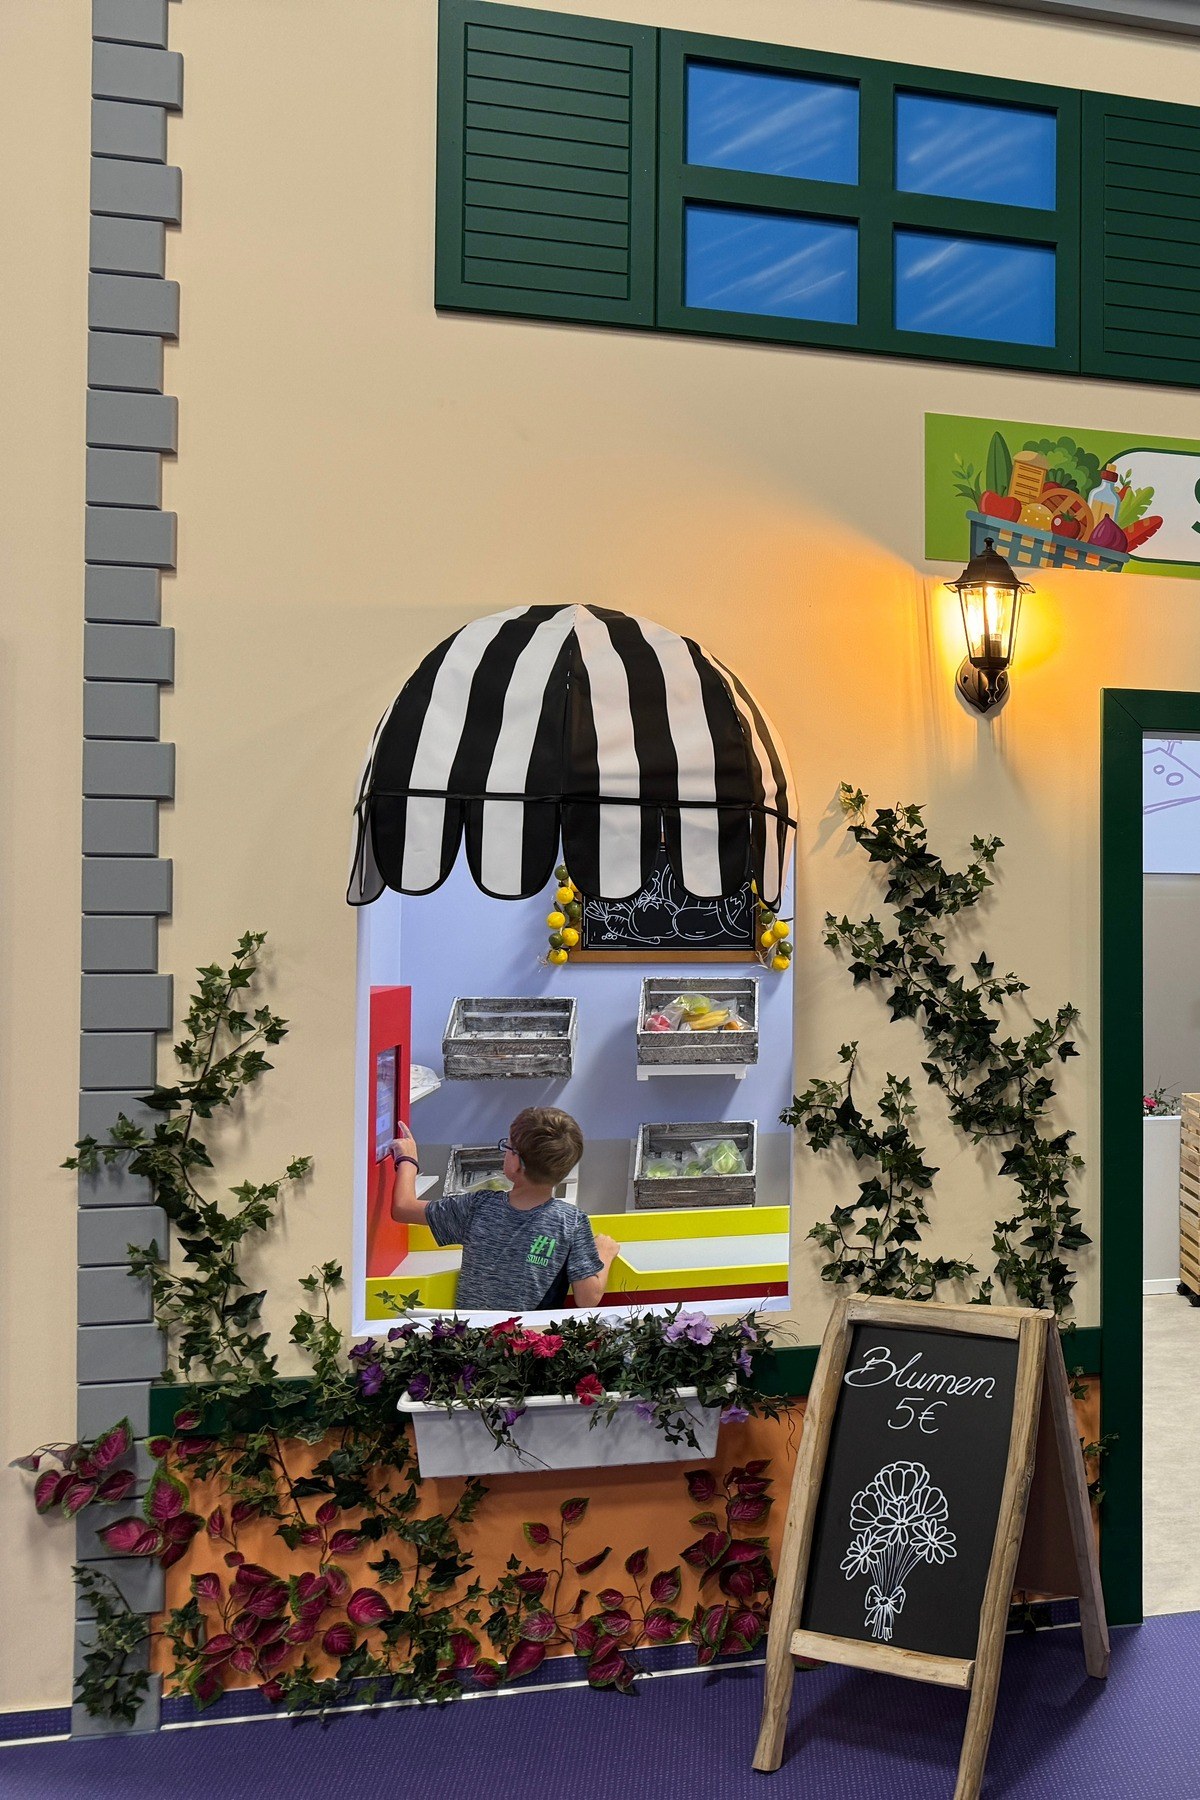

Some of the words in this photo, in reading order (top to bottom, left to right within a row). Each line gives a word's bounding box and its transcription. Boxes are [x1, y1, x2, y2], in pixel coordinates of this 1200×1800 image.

[526, 1254, 549, 1268] SQUAD
[530, 1235, 556, 1258] #1
[844, 1346, 996, 1399] Blumen
[887, 1397, 948, 1434] 5€
